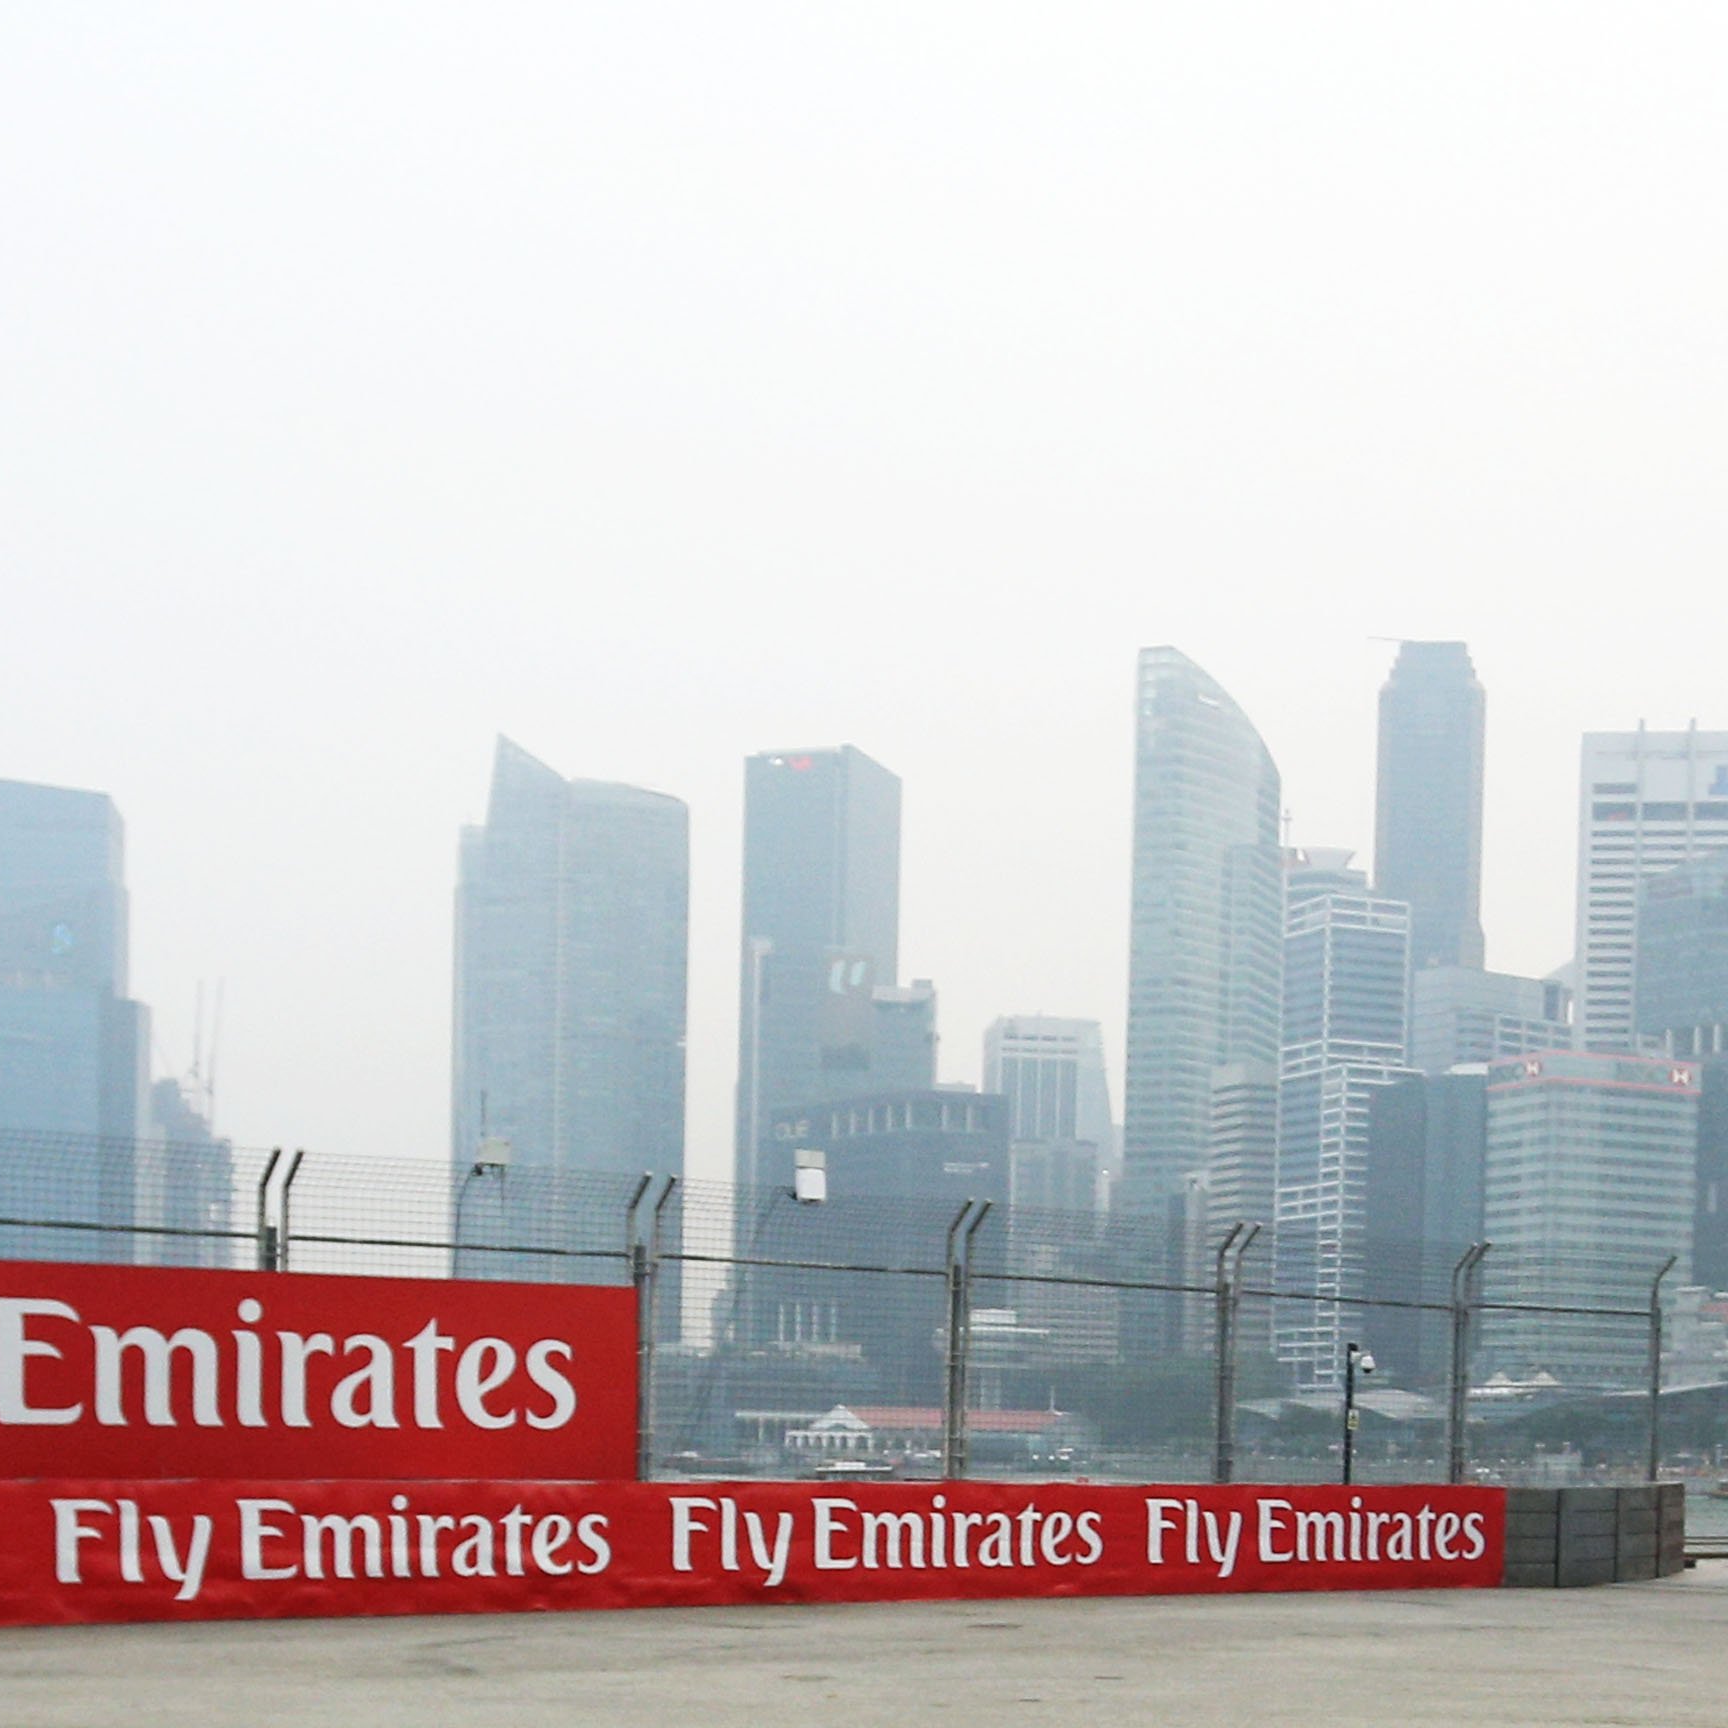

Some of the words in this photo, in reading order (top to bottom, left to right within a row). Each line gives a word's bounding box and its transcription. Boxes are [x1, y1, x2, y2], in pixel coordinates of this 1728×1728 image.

[50, 1499, 212, 1600] Fly
[236, 1495, 610, 1579] Emirates
[669, 1497, 793, 1586] Fly
[812, 1495, 1102, 1569] Emirates
[1146, 1499, 1241, 1577] Fly
[1257, 1497, 1484, 1561] Emirates
